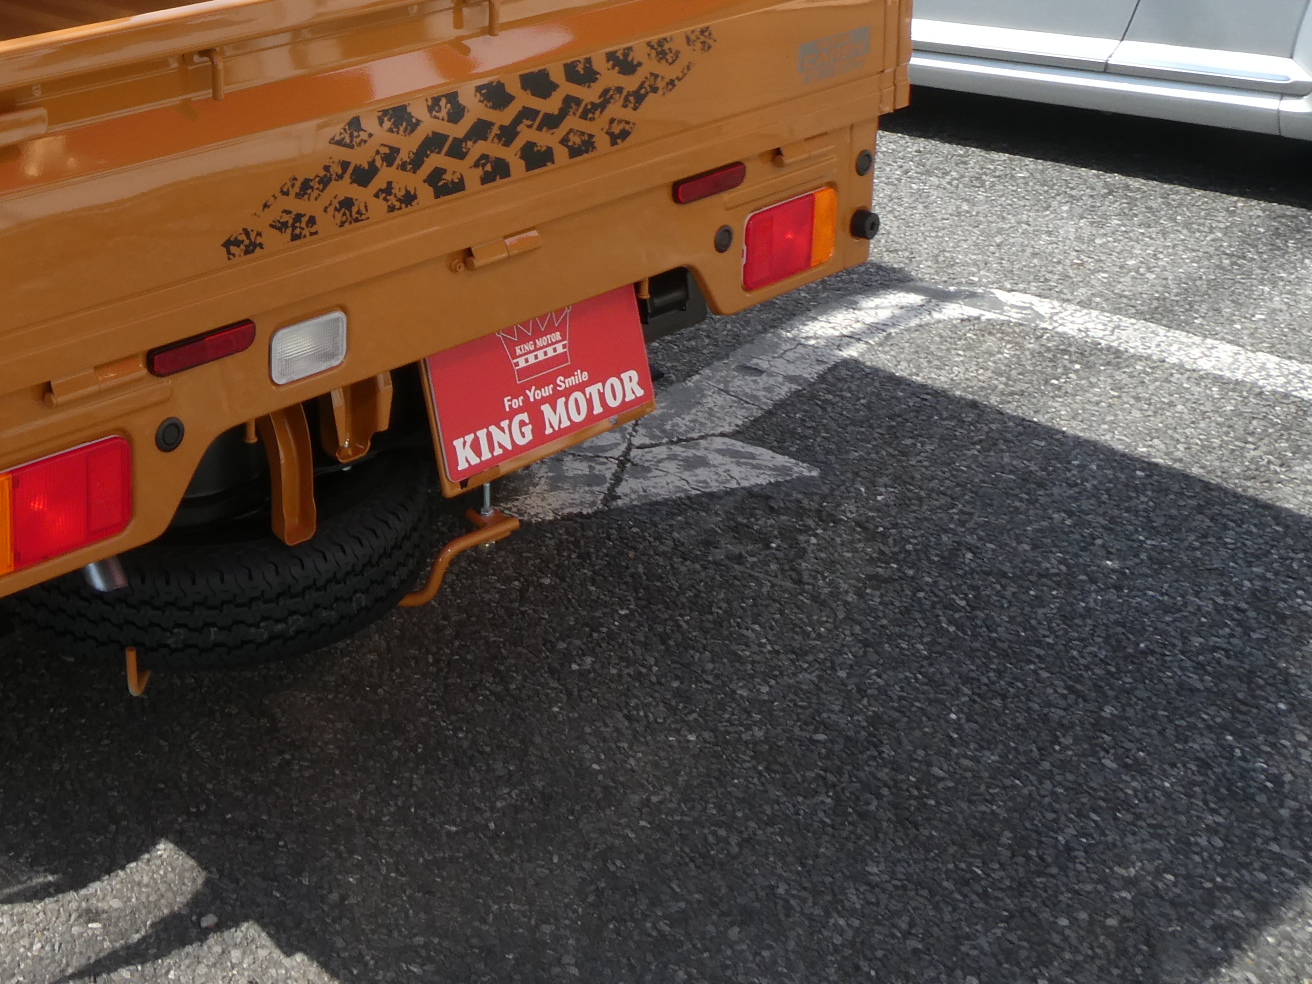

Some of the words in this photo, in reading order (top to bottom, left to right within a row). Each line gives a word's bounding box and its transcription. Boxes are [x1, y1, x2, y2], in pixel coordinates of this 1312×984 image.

[515, 338, 535, 355] KING
[536, 331, 562, 348] MOTOR
[504, 396, 524, 411] For
[525, 385, 554, 403] Your
[556, 369, 588, 391] Smile
[452, 412, 533, 471] KING
[541, 369, 645, 435] MOTOR
